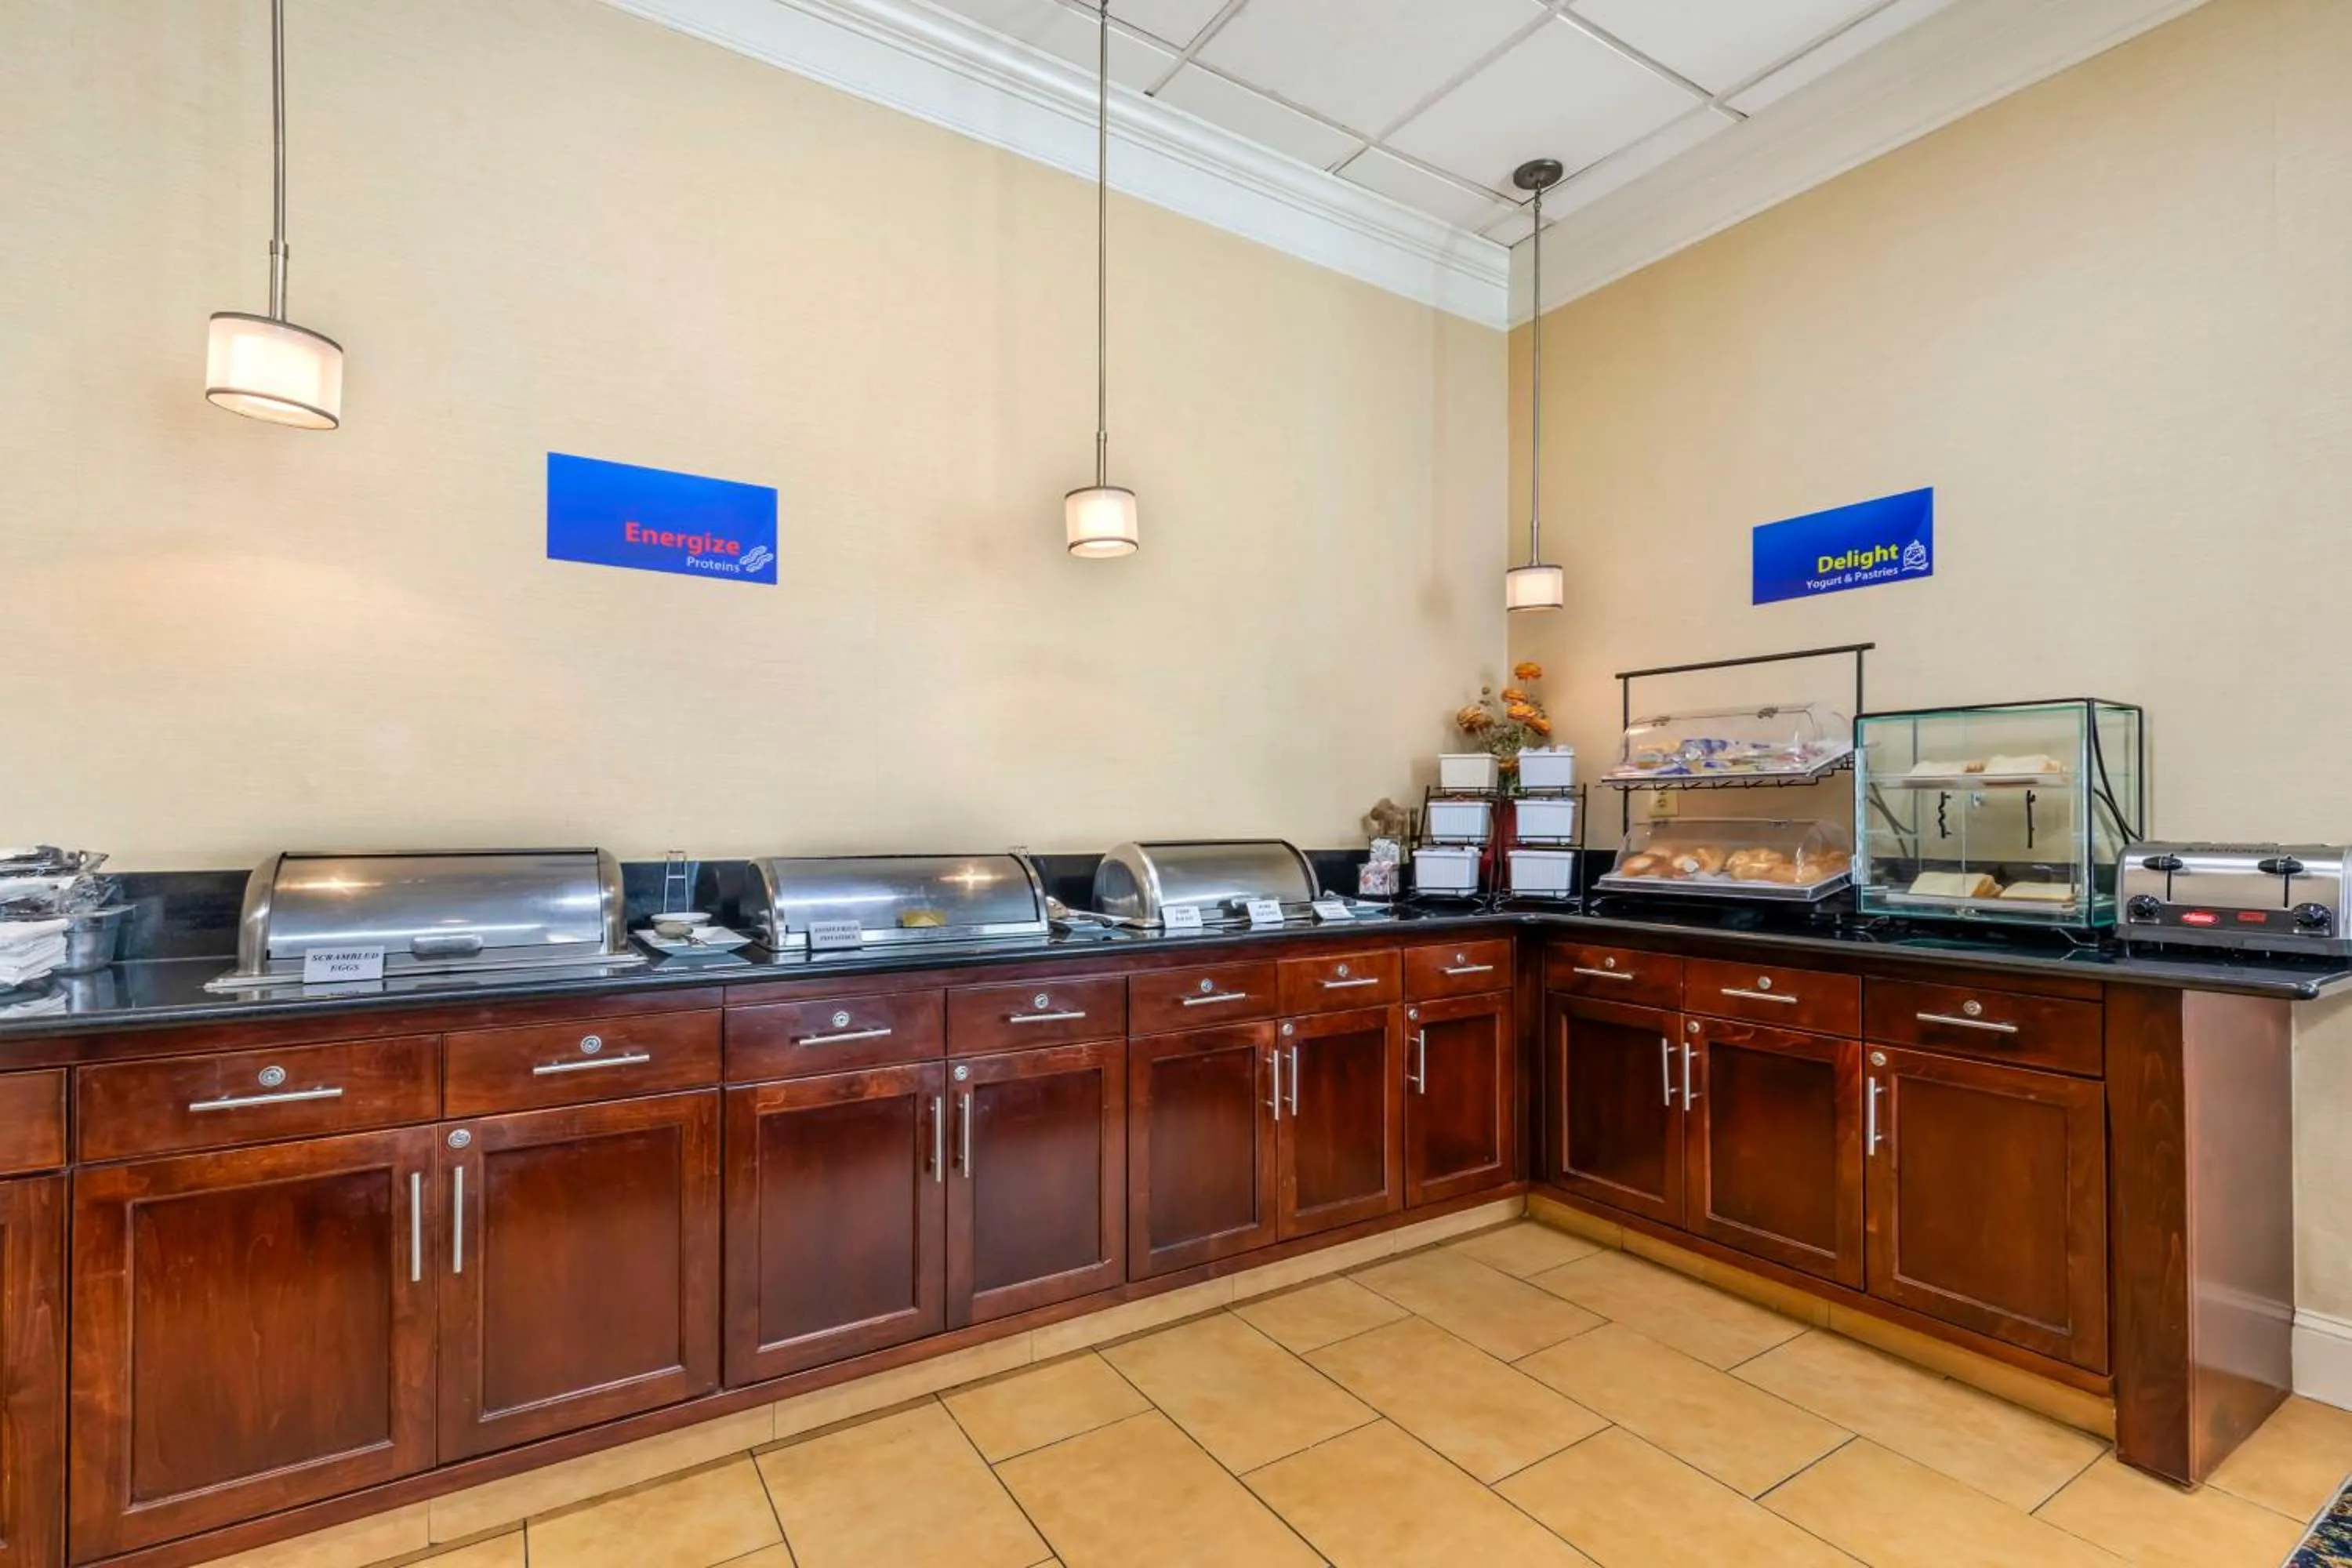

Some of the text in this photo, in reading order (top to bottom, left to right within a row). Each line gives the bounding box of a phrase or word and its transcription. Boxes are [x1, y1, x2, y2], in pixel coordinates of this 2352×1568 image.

[626, 521, 741, 555] Energize
[687, 557, 741, 574] Proteins
[1818, 543, 1899, 574] Delight
[1806, 567, 1898, 590] Yogurt & Pastries
[312, 953, 379, 961] SCRAMBLED
